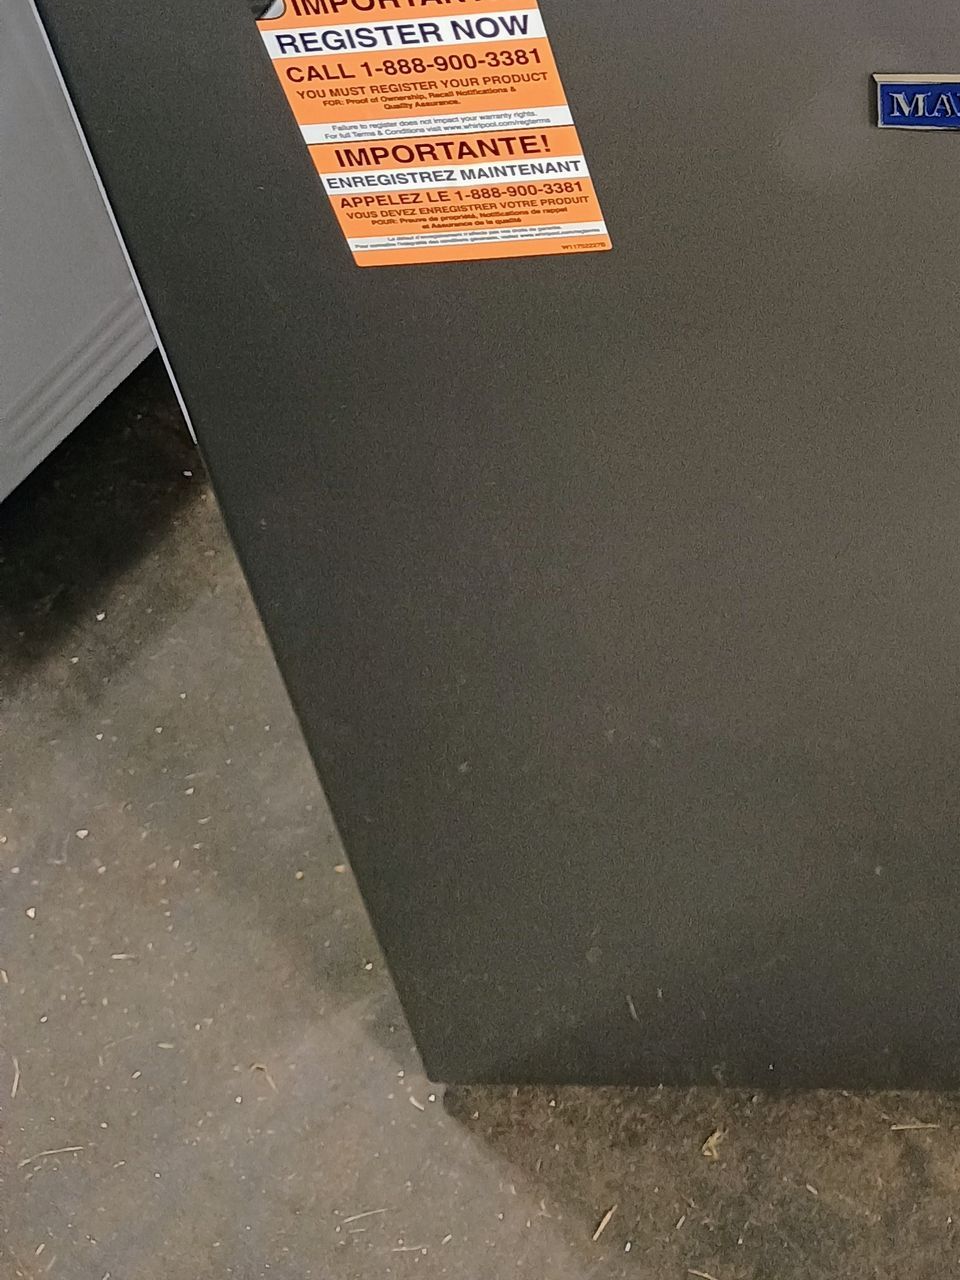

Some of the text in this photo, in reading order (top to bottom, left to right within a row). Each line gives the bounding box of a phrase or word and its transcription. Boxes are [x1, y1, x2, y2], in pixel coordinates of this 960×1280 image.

[275, 14, 529, 55] REGISTER NOW
[286, 47, 542, 83] CALL 1-888-900-3381
[296, 72, 548, 100] YOU MUST REGISTER YOUR PRODUCT
[334, 135, 551, 167] IMPORTANTE!
[325, 160, 581, 189] ENREGISTREZ MAINTENANT
[340, 181, 583, 208] APPELEZ LE 1-888-900-3381
[380, 208, 417, 217] DEVEZ
[419, 203, 498, 215] ENREGISTRER
[501, 200, 538, 209] VOTRE
[541, 195, 589, 206] PRODUIT
